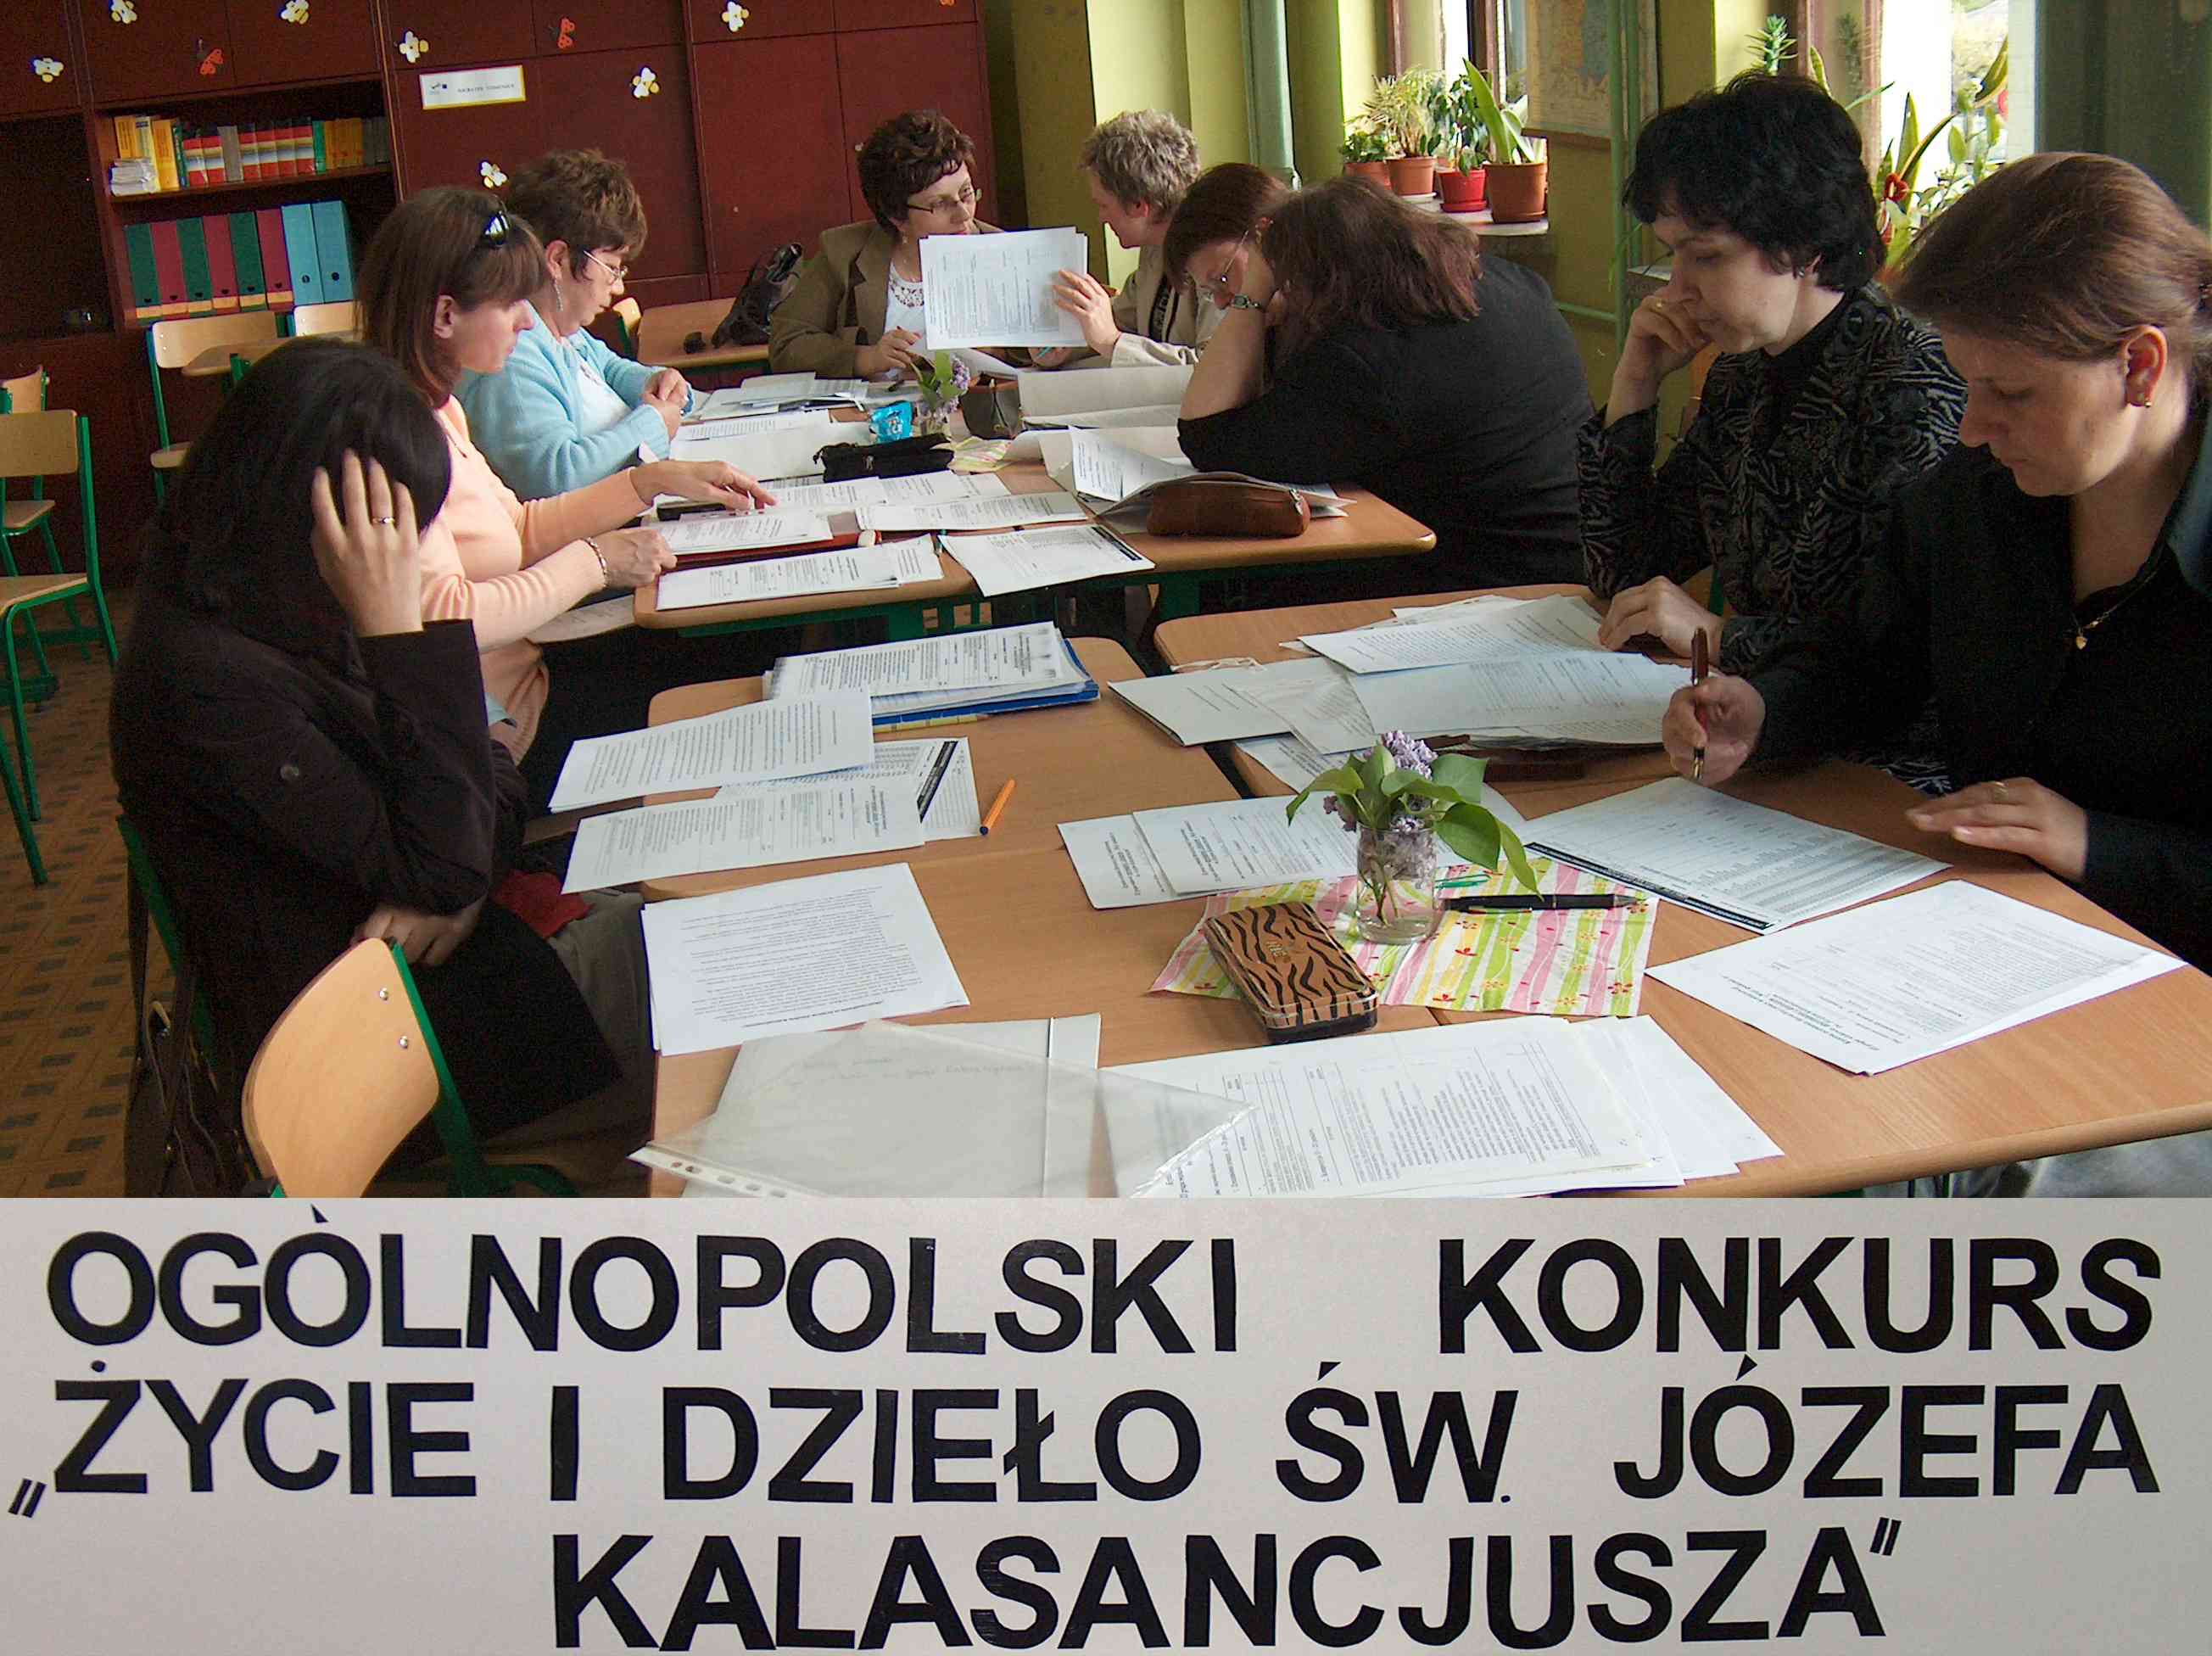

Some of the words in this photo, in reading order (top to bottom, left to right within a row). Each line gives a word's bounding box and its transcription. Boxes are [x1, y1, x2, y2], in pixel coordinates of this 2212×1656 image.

[1439, 1236, 2161, 1354] KONKURS
[550, 1385, 579, 1502] I
[663, 1386, 1201, 1504] DZIEŁO
[1276, 1361, 1519, 1504] ŚW.
[1613, 1355, 2161, 1499] JÓZEFA
